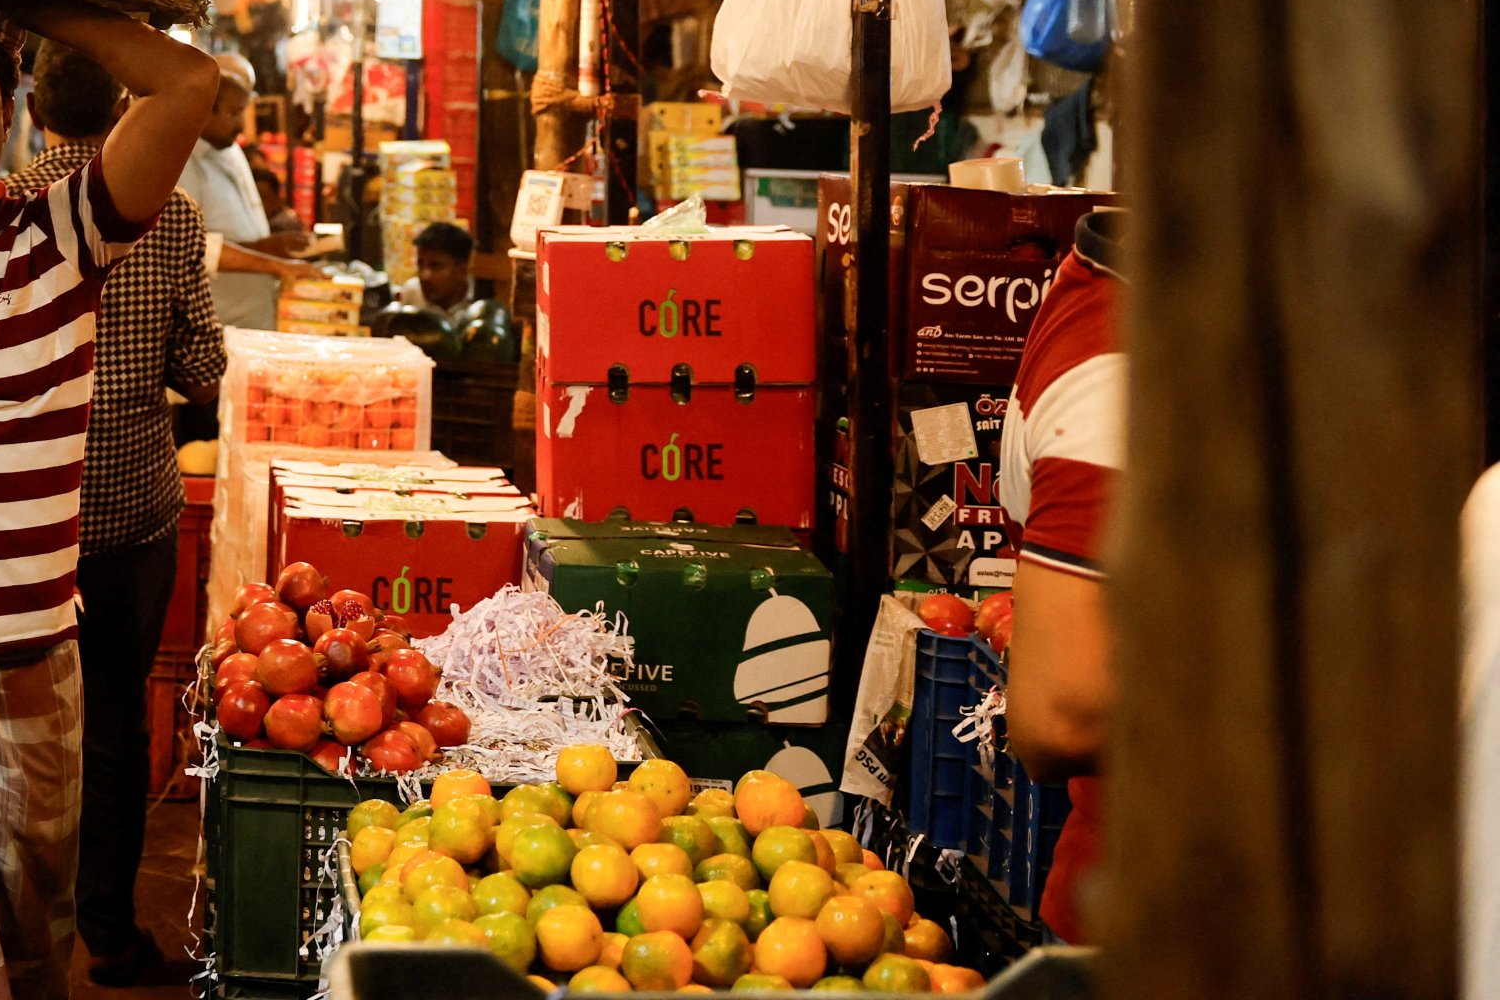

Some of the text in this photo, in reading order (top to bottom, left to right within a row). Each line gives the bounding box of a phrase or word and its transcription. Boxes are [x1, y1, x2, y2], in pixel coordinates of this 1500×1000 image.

[827, 202, 851, 245] se
[922, 269, 1052, 323] serpi
[976, 394, 1008, 416] ÖZ
[955, 462, 1001, 506] N
[959, 508, 1004, 524] FR
[956, 531, 1003, 550] AP
[611, 663, 674, 682] EFIVE
[620, 683, 657, 692] CUSSED
[855, 749, 880, 775] PSG
